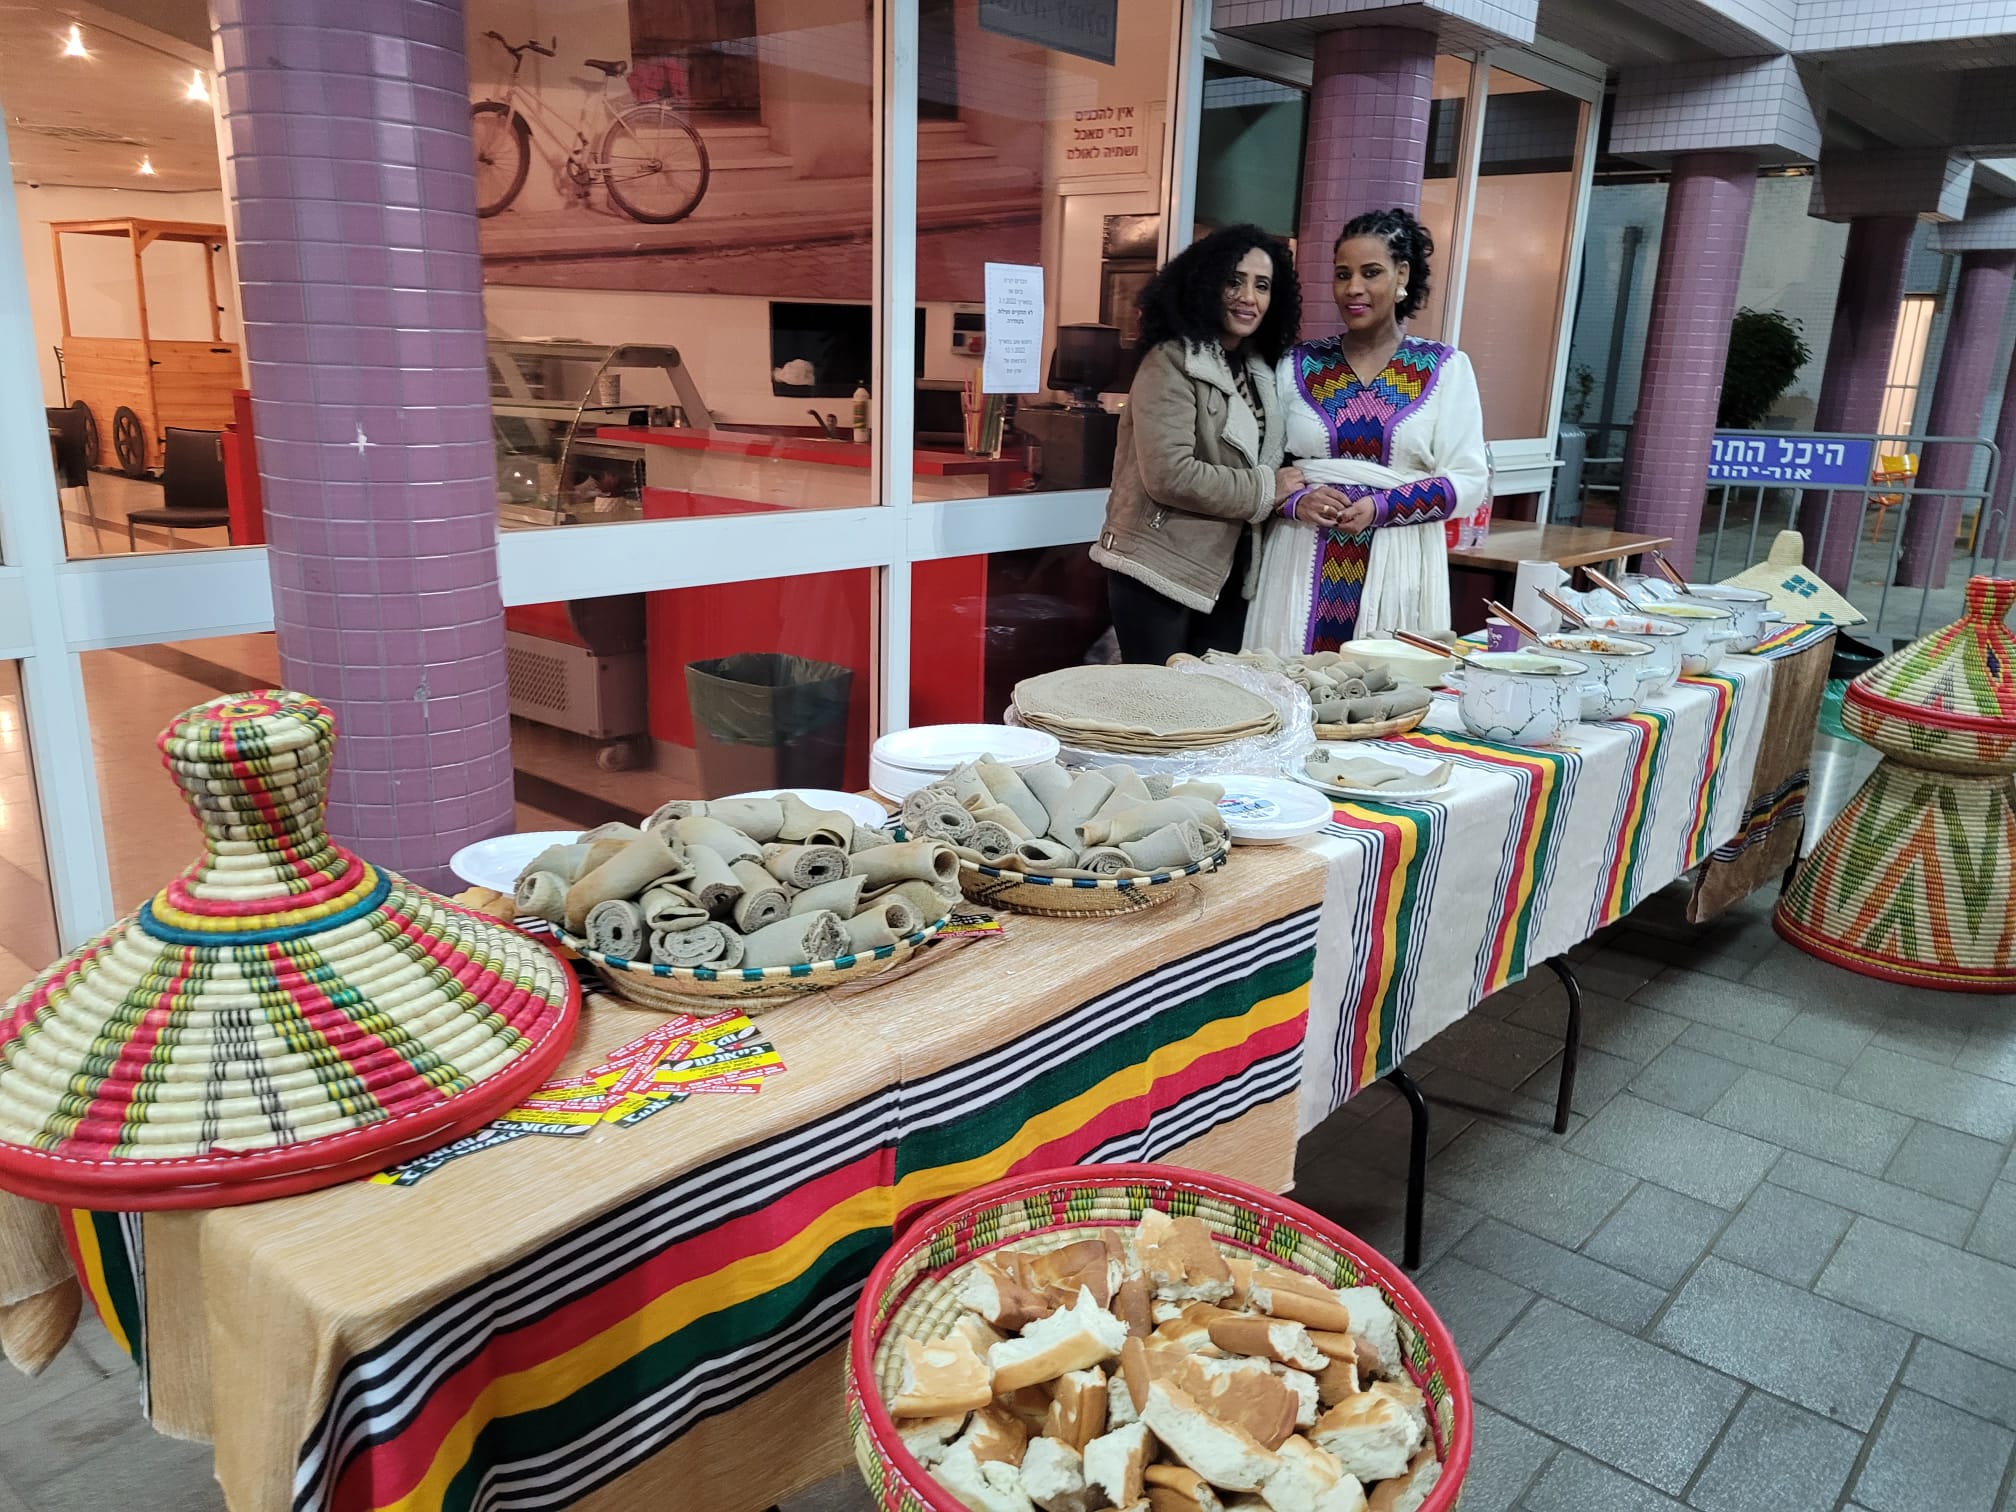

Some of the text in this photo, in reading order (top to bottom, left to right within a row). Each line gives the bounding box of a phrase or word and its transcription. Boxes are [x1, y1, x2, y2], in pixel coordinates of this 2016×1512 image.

[1117, 106, 1135, 121] אין
[1073, 126, 1133, 140] דברי מאכל
[1066, 145, 1138, 160] ושתיה לאולם
[1778, 437, 1846, 466] היכל
